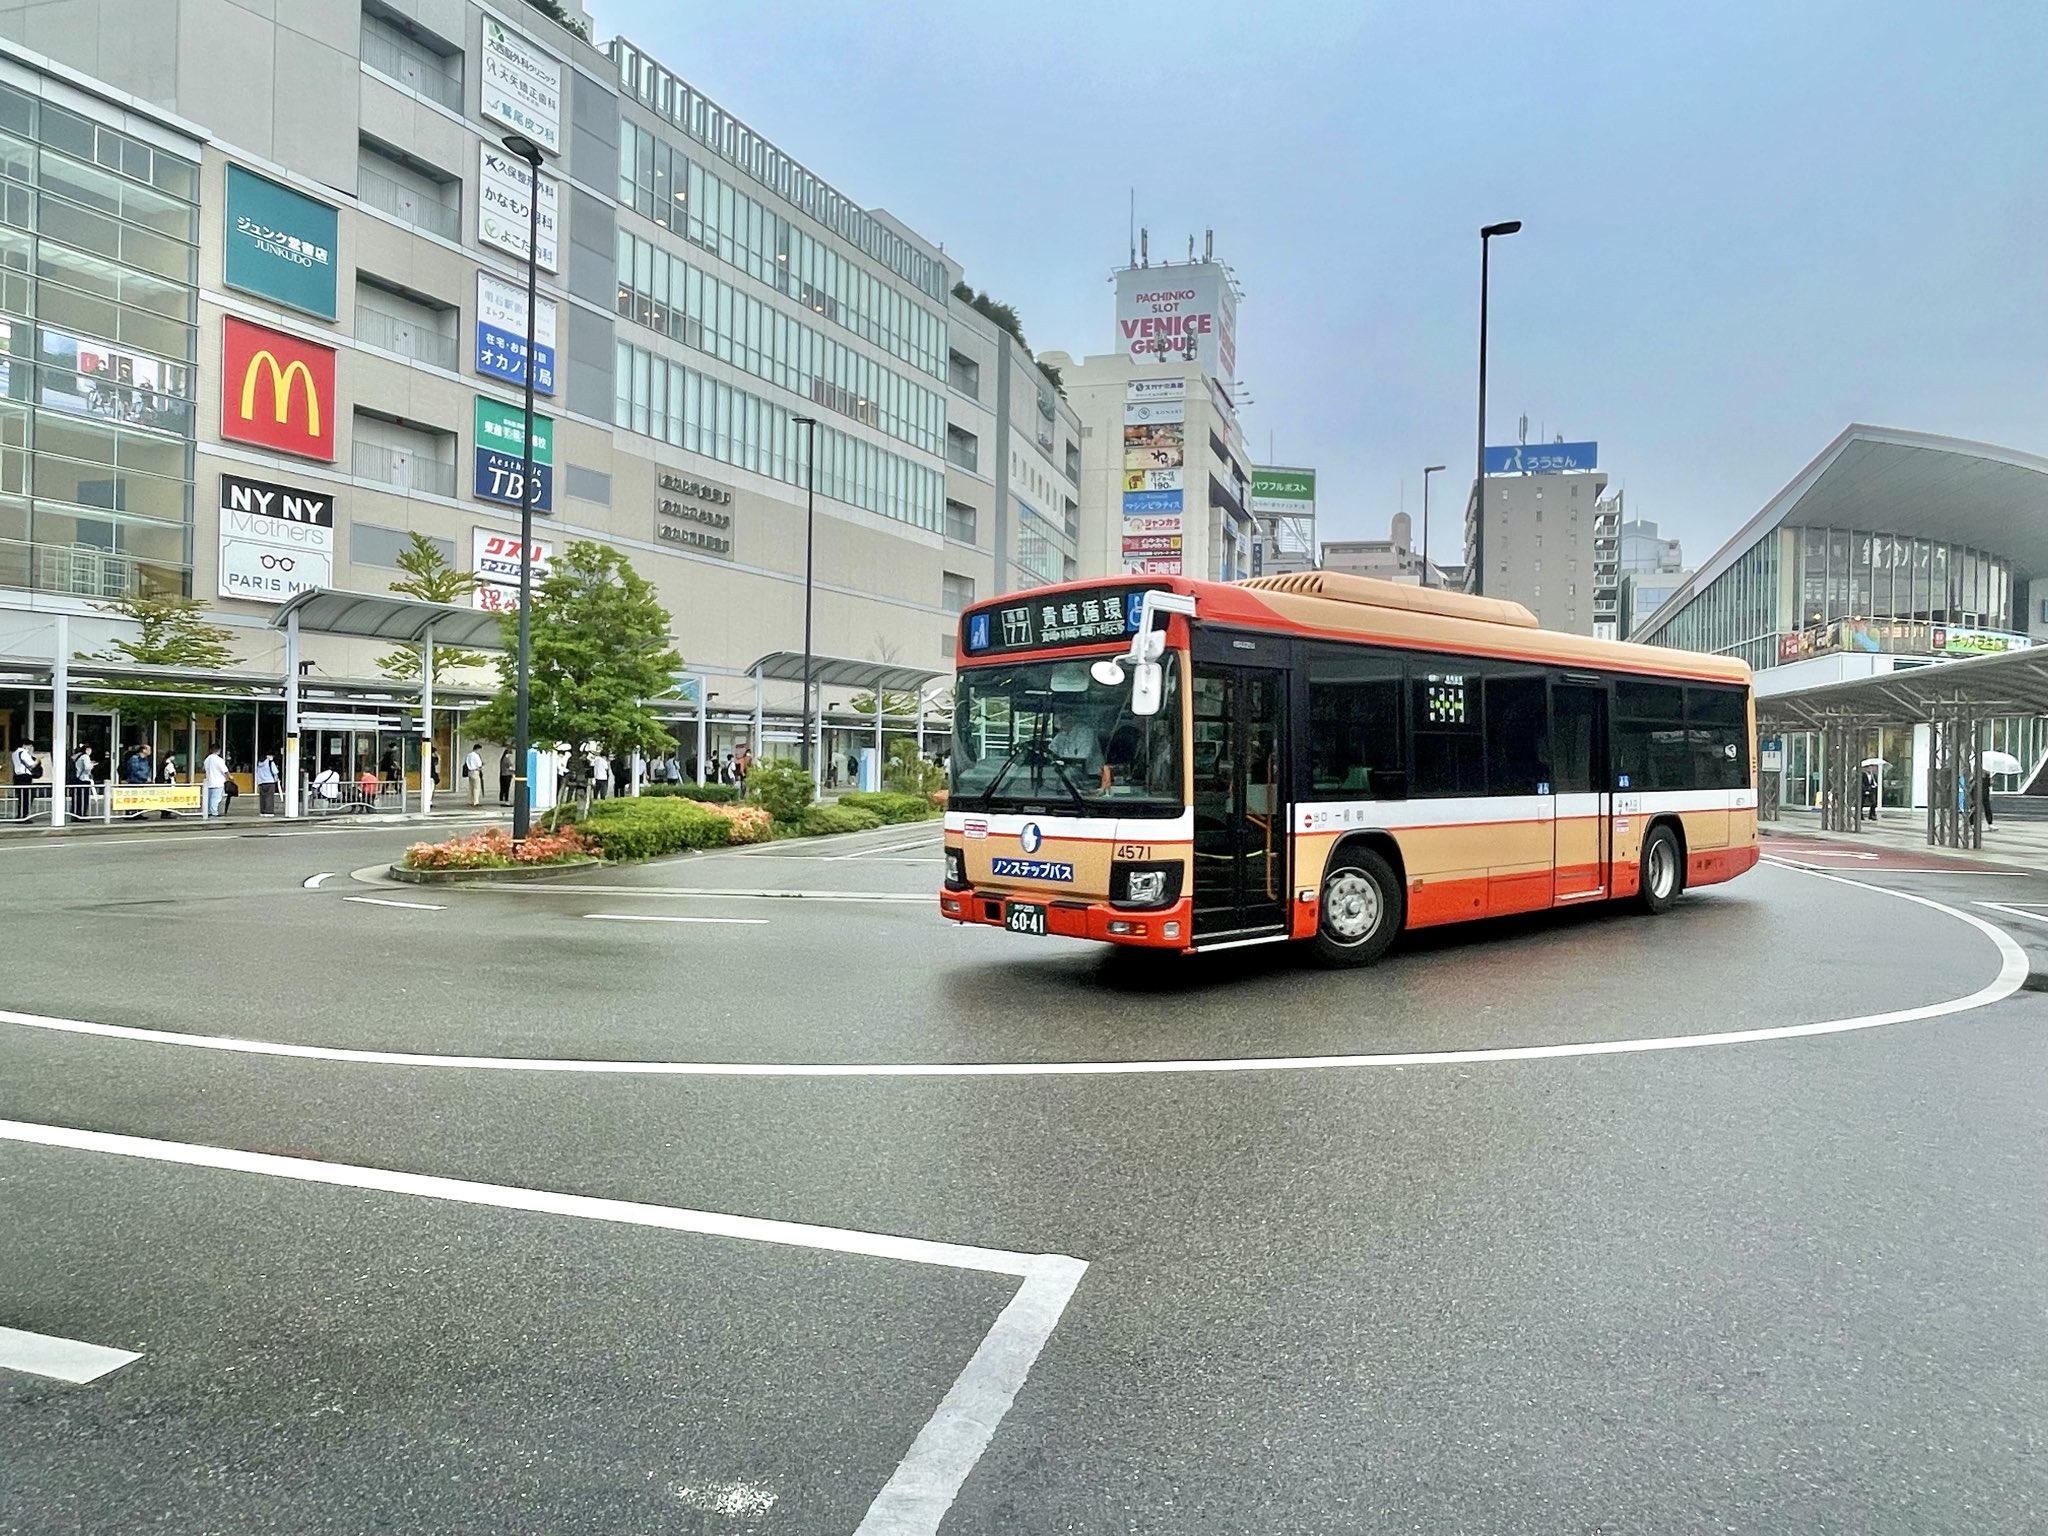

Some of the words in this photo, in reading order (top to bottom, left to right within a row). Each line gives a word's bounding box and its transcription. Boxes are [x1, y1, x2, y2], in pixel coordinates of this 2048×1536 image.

[500, 70, 556, 110] 大矢矯正歯科
[237, 216, 329, 262] ジュンク堂書店
[254, 239, 313, 268] JUNKUDO
[1135, 289, 1196, 304] PACHINKO
[1151, 302, 1180, 314] SLOT
[1119, 313, 1212, 339] VENICE
[1130, 337, 1197, 354] GROU
[489, 455, 542, 477] Aesthic
[1526, 456, 1578, 469] ろうきん
[1252, 481, 1308, 493] パワフルポスト
[230, 484, 276, 515] NY
[282, 494, 324, 524] NY
[230, 510, 324, 545] Mothers
[484, 537, 543, 562] クスリ
[481, 558, 544, 578] オーエスド
[1148, 561, 1182, 575] 日能研
[229, 573, 281, 591] PARIS
[288, 581, 319, 593] MI
[1041, 597, 1124, 629] 貴崎循環
[1006, 623, 1027, 644] 77
[1117, 845, 1152, 860] 4571
[993, 860, 1073, 880] ノンステップバス
